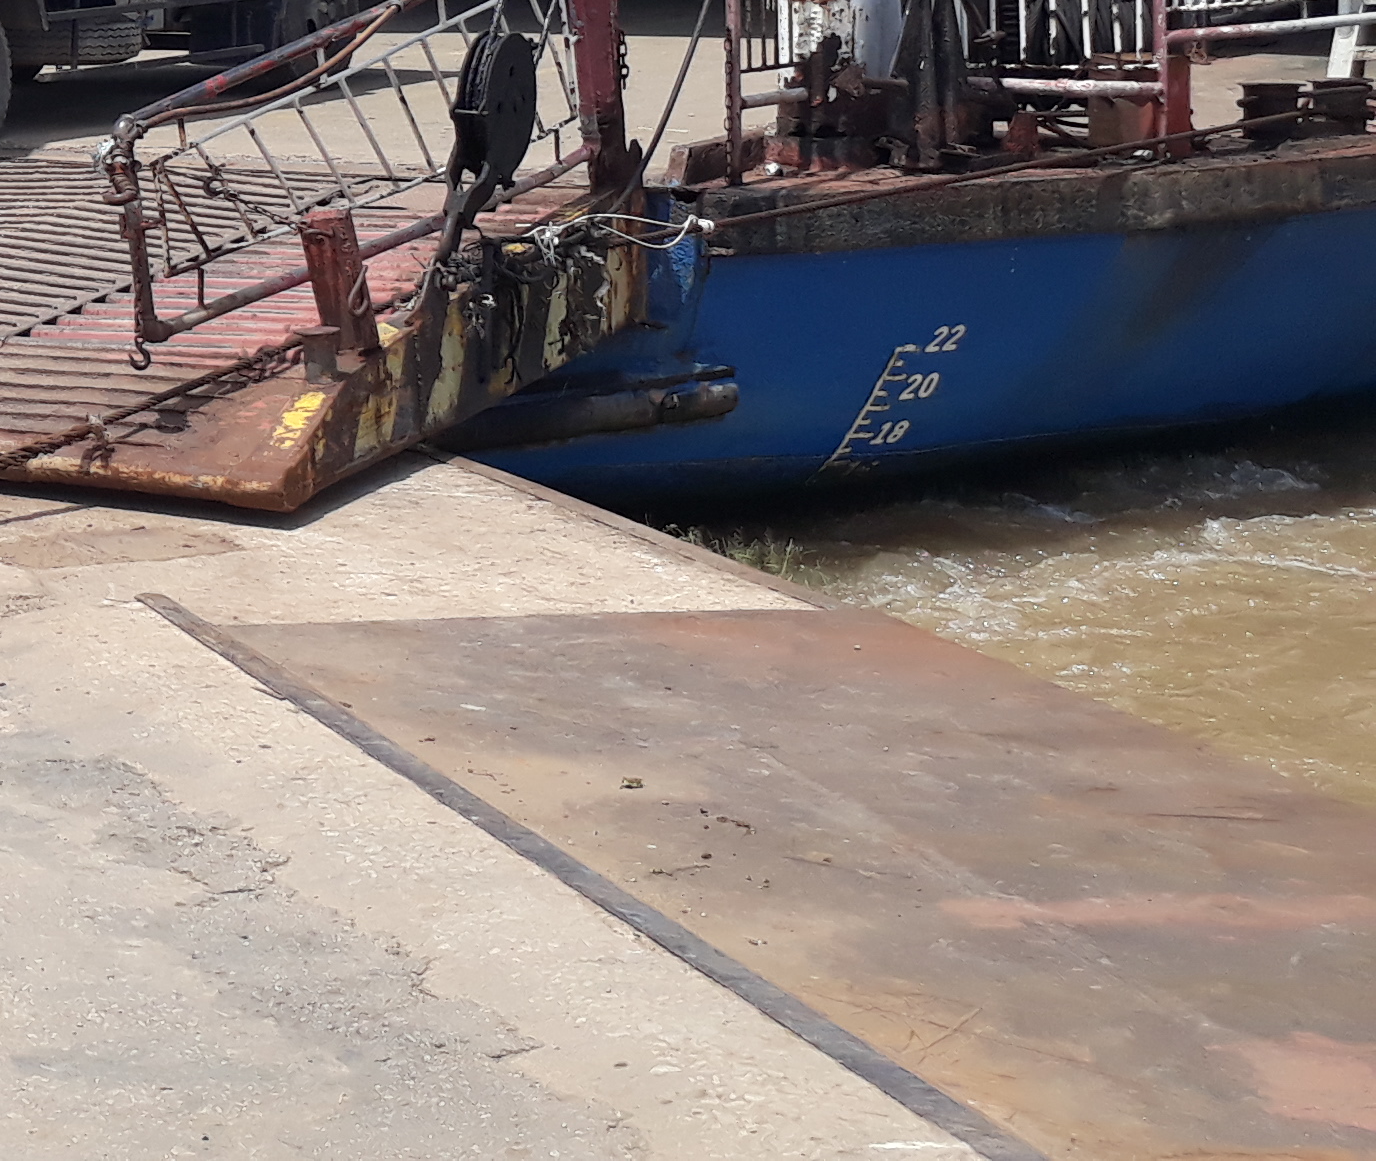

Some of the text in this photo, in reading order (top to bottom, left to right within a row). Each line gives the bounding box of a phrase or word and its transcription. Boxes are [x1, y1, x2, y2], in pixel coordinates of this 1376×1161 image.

[924, 324, 967, 353] 22
[898, 371, 940, 401] 20
[869, 419, 910, 445] 18
